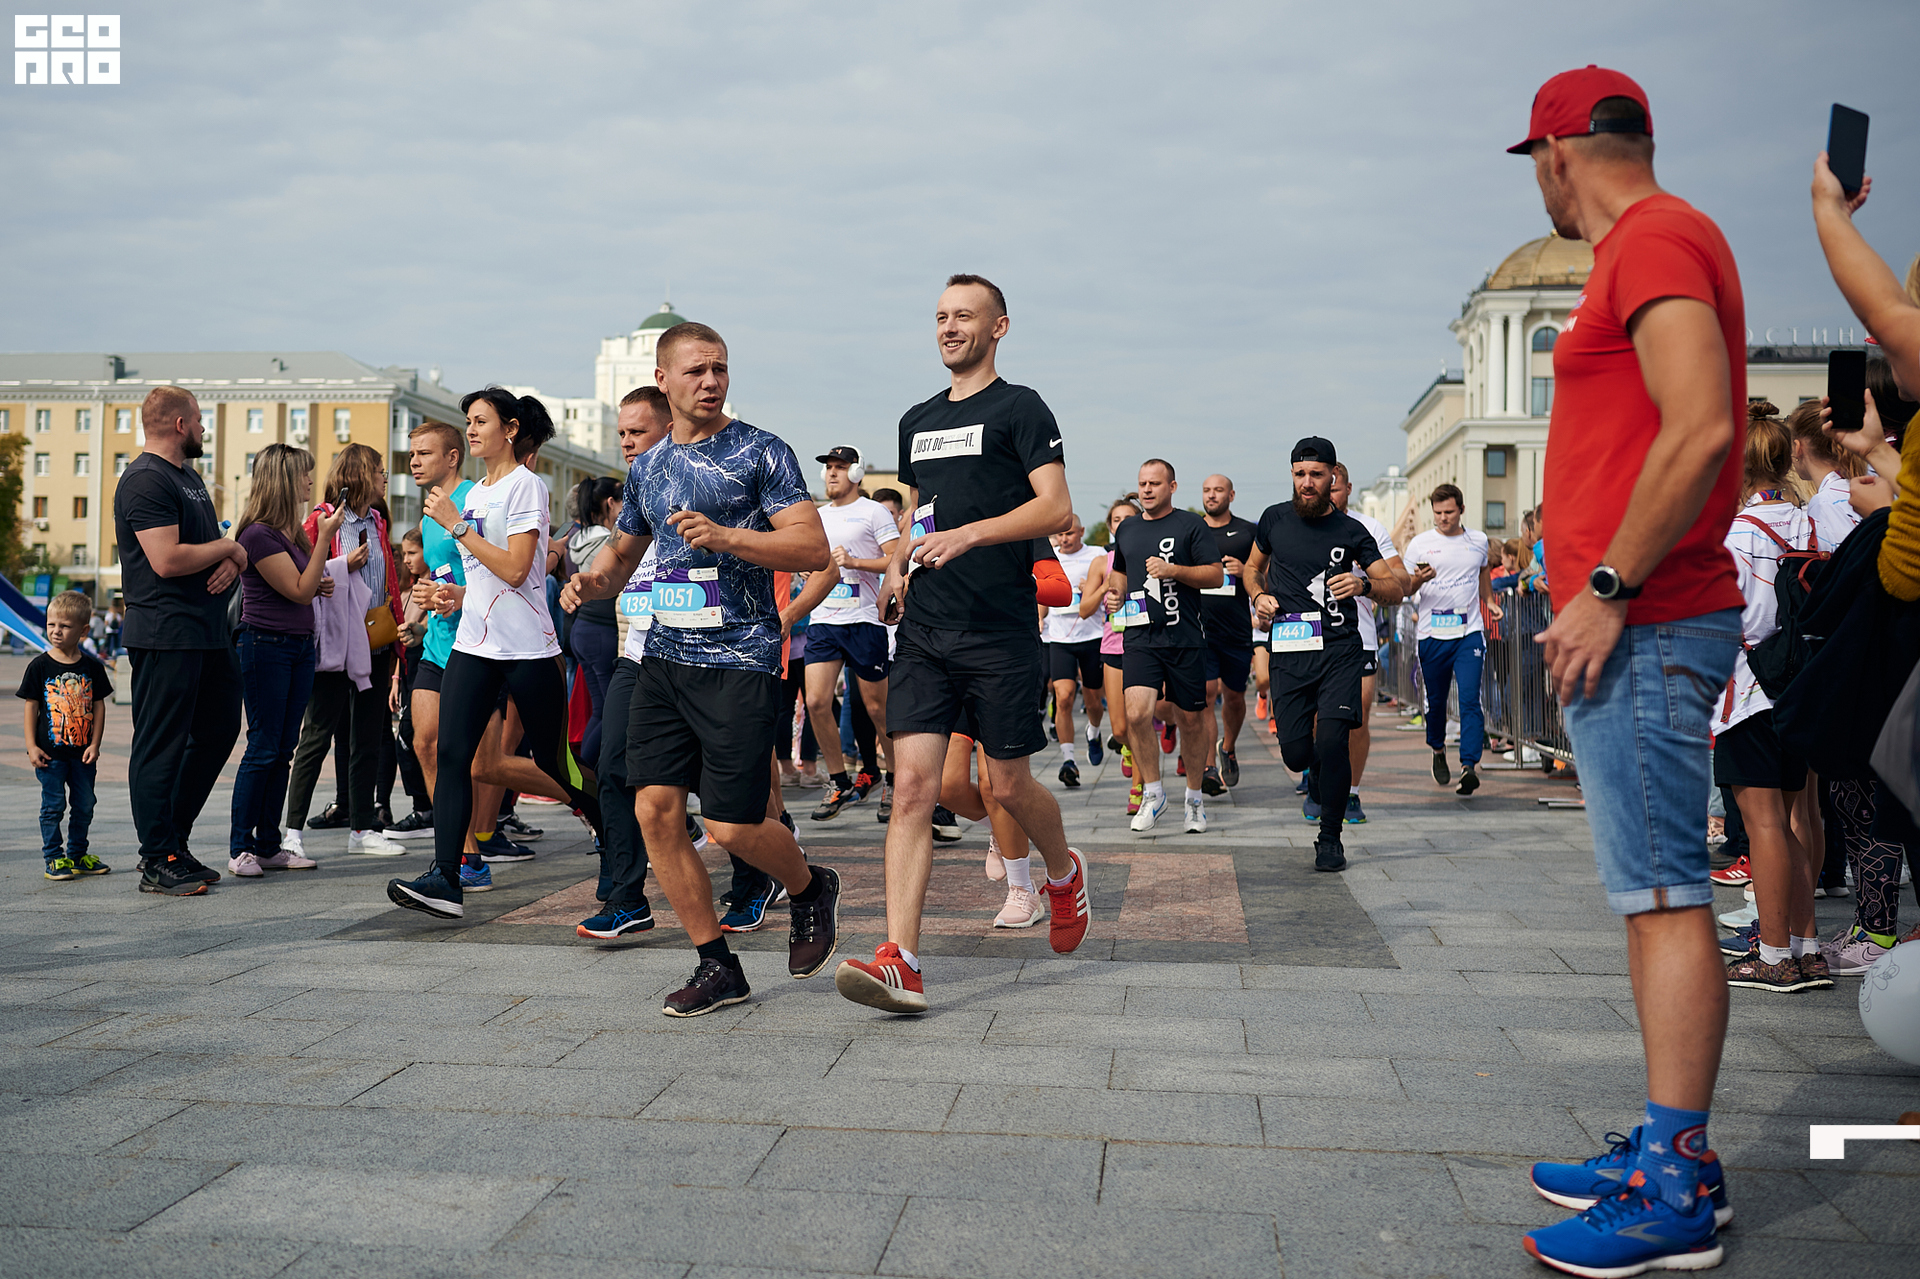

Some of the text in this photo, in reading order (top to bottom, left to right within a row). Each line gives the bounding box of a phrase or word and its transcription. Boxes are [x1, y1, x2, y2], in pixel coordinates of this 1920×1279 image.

[1746, 326, 1870, 346] ОСТИН
[914, 437, 933, 454] JUST
[932, 436, 944, 452] DO
[658, 587, 694, 608] 1051
[1435, 616, 1458, 627] 1322
[1277, 624, 1306, 639] 1441
